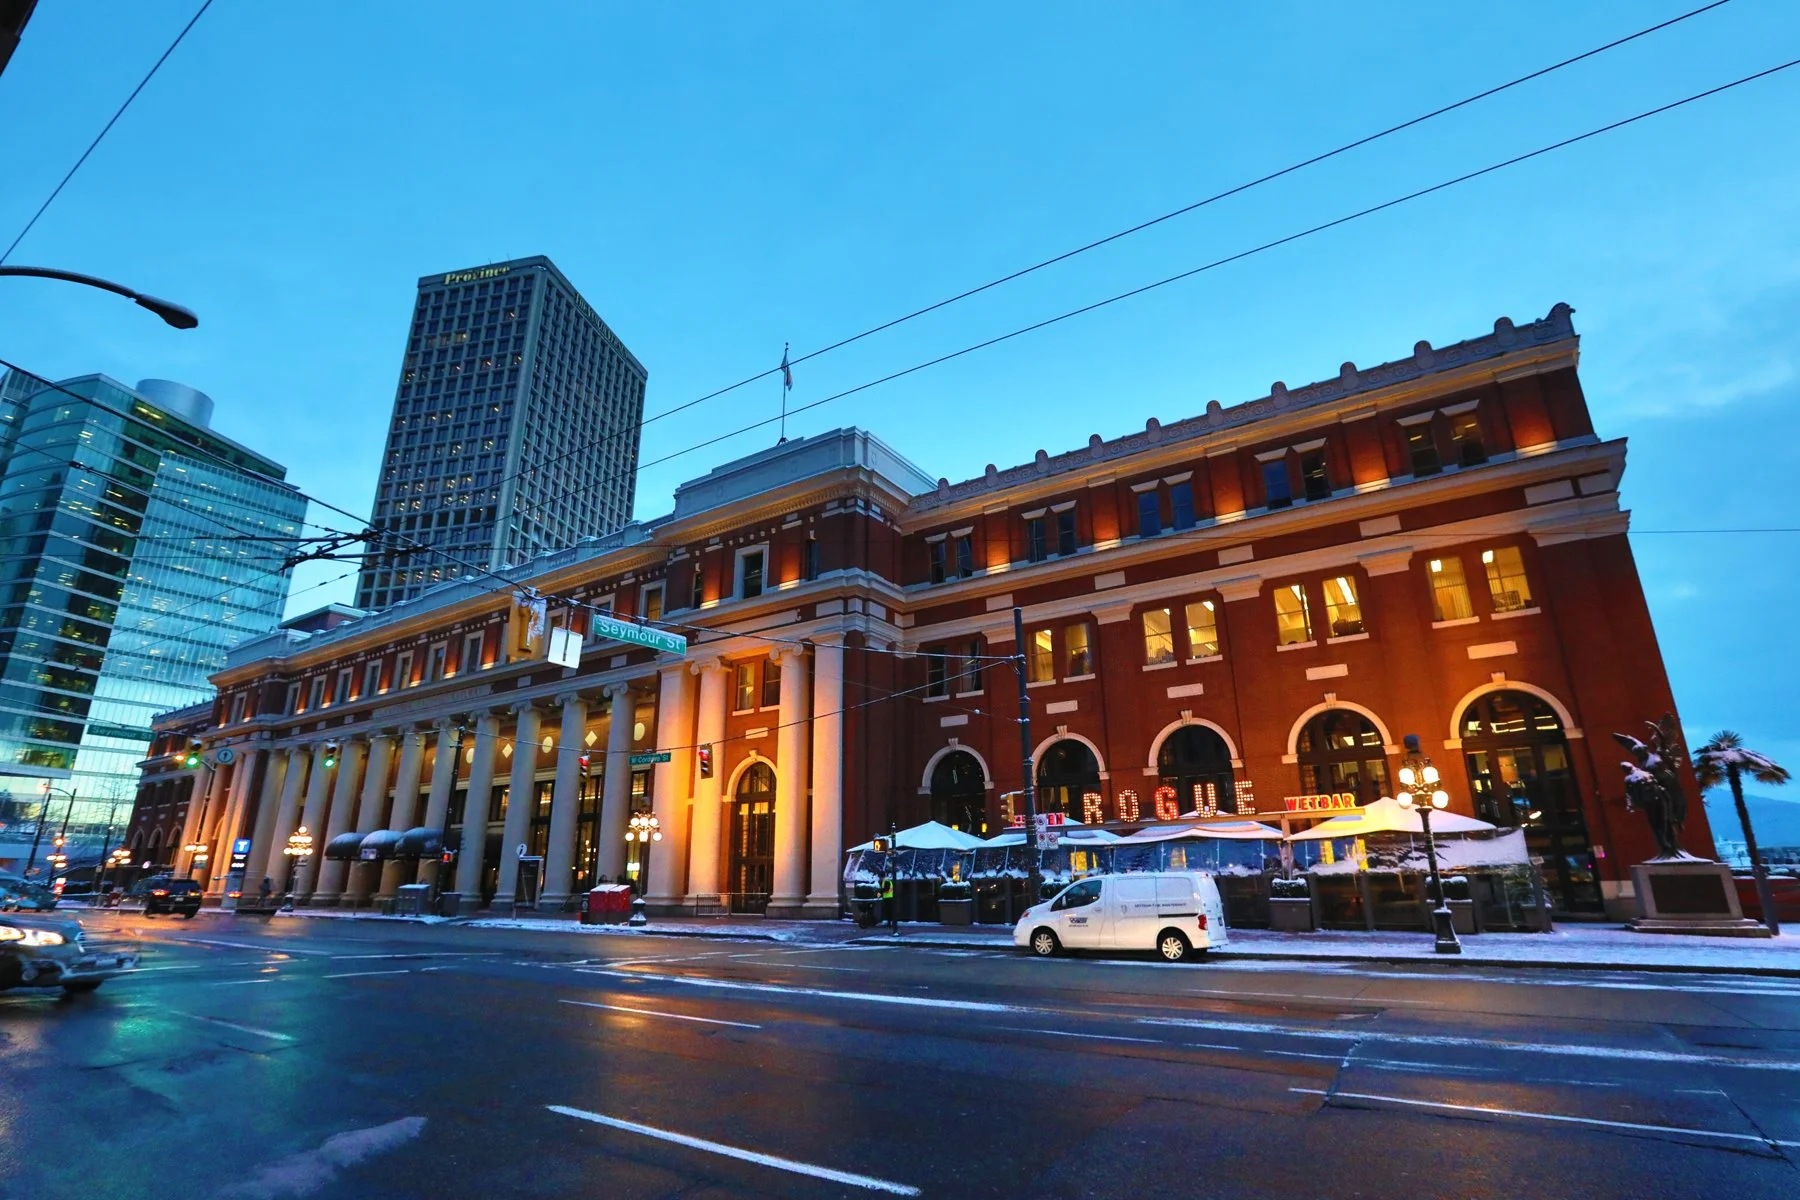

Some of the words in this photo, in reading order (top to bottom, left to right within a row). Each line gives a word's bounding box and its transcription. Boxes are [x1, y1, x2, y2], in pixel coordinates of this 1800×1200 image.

[443, 265, 510, 285] Province
[600, 620, 660, 645] Seymour
[666, 638, 680, 650] St
[91, 726, 137, 738] Seymour
[140, 732, 152, 741] St
[1082, 780, 1257, 825] ROGUE
[1284, 793, 1356, 812] WETBAR
